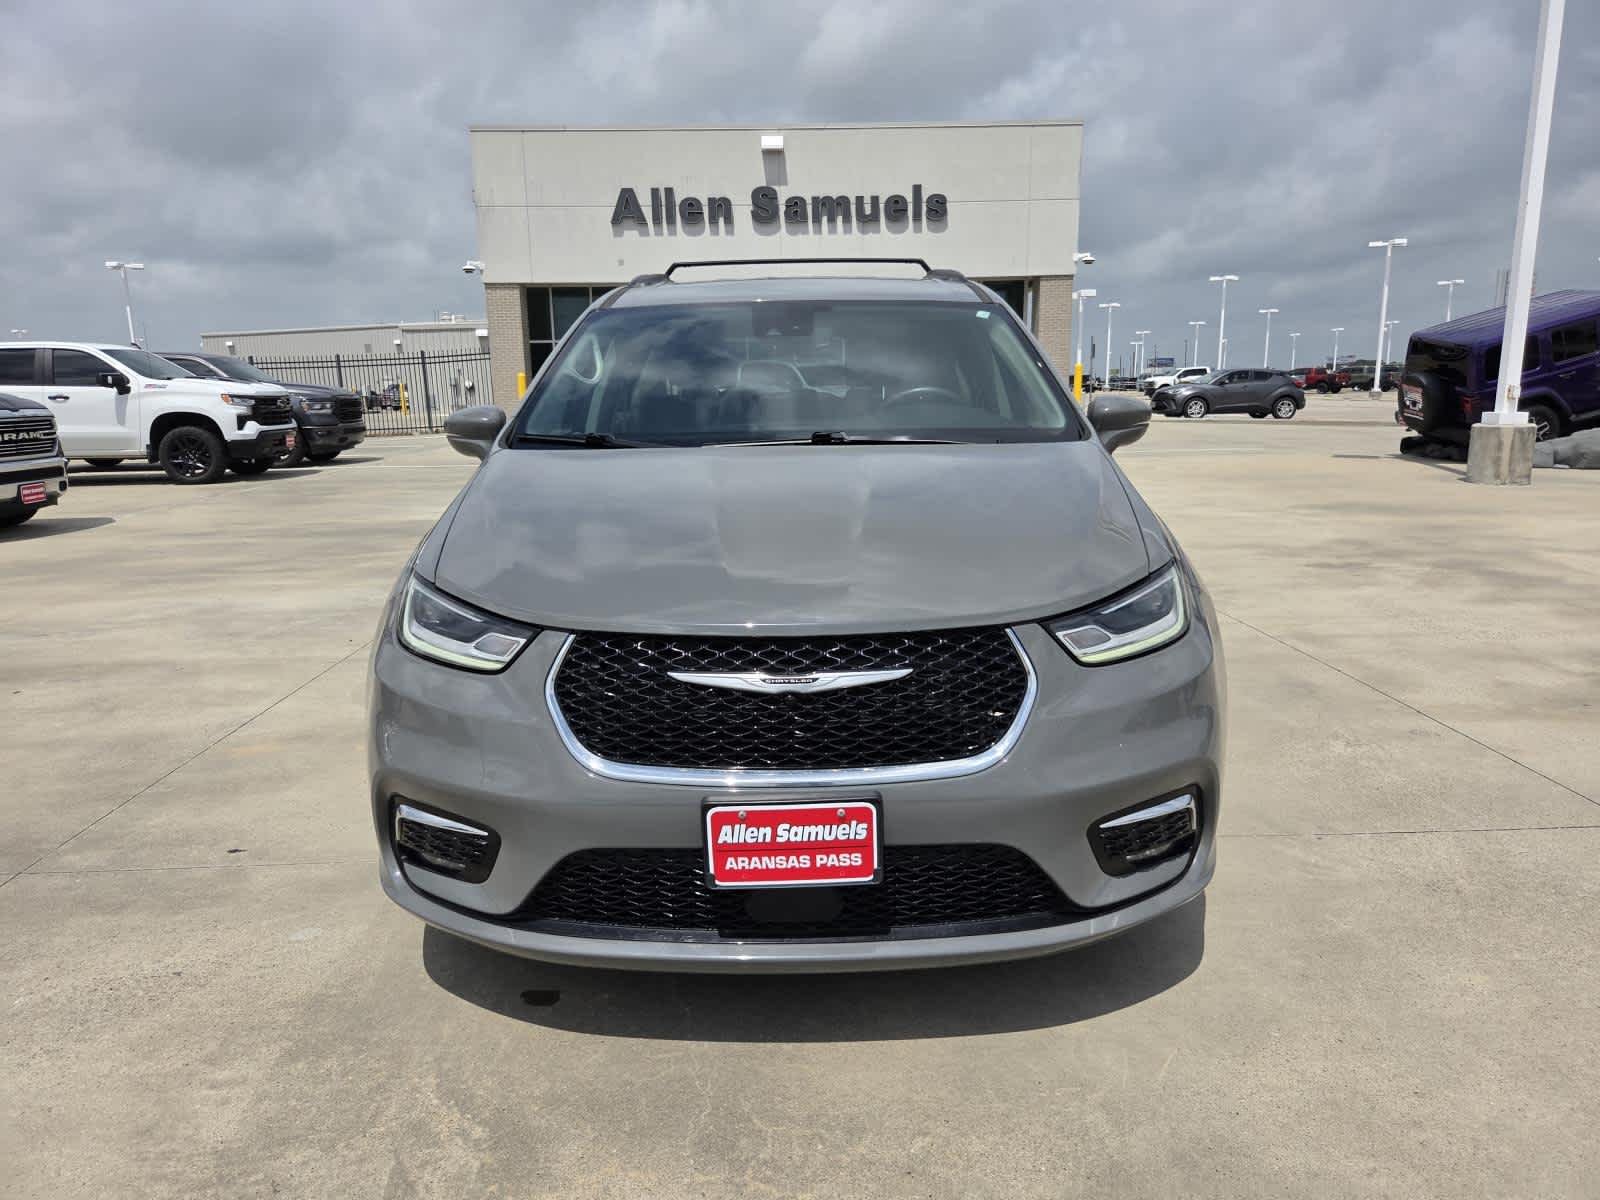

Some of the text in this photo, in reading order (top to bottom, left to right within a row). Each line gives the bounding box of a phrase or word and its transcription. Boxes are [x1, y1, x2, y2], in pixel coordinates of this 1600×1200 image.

[610, 184, 948, 225] Allen Samuels
[717, 820, 868, 844] Allen Samuels
[725, 853, 862, 870] ARANSAS PASS
